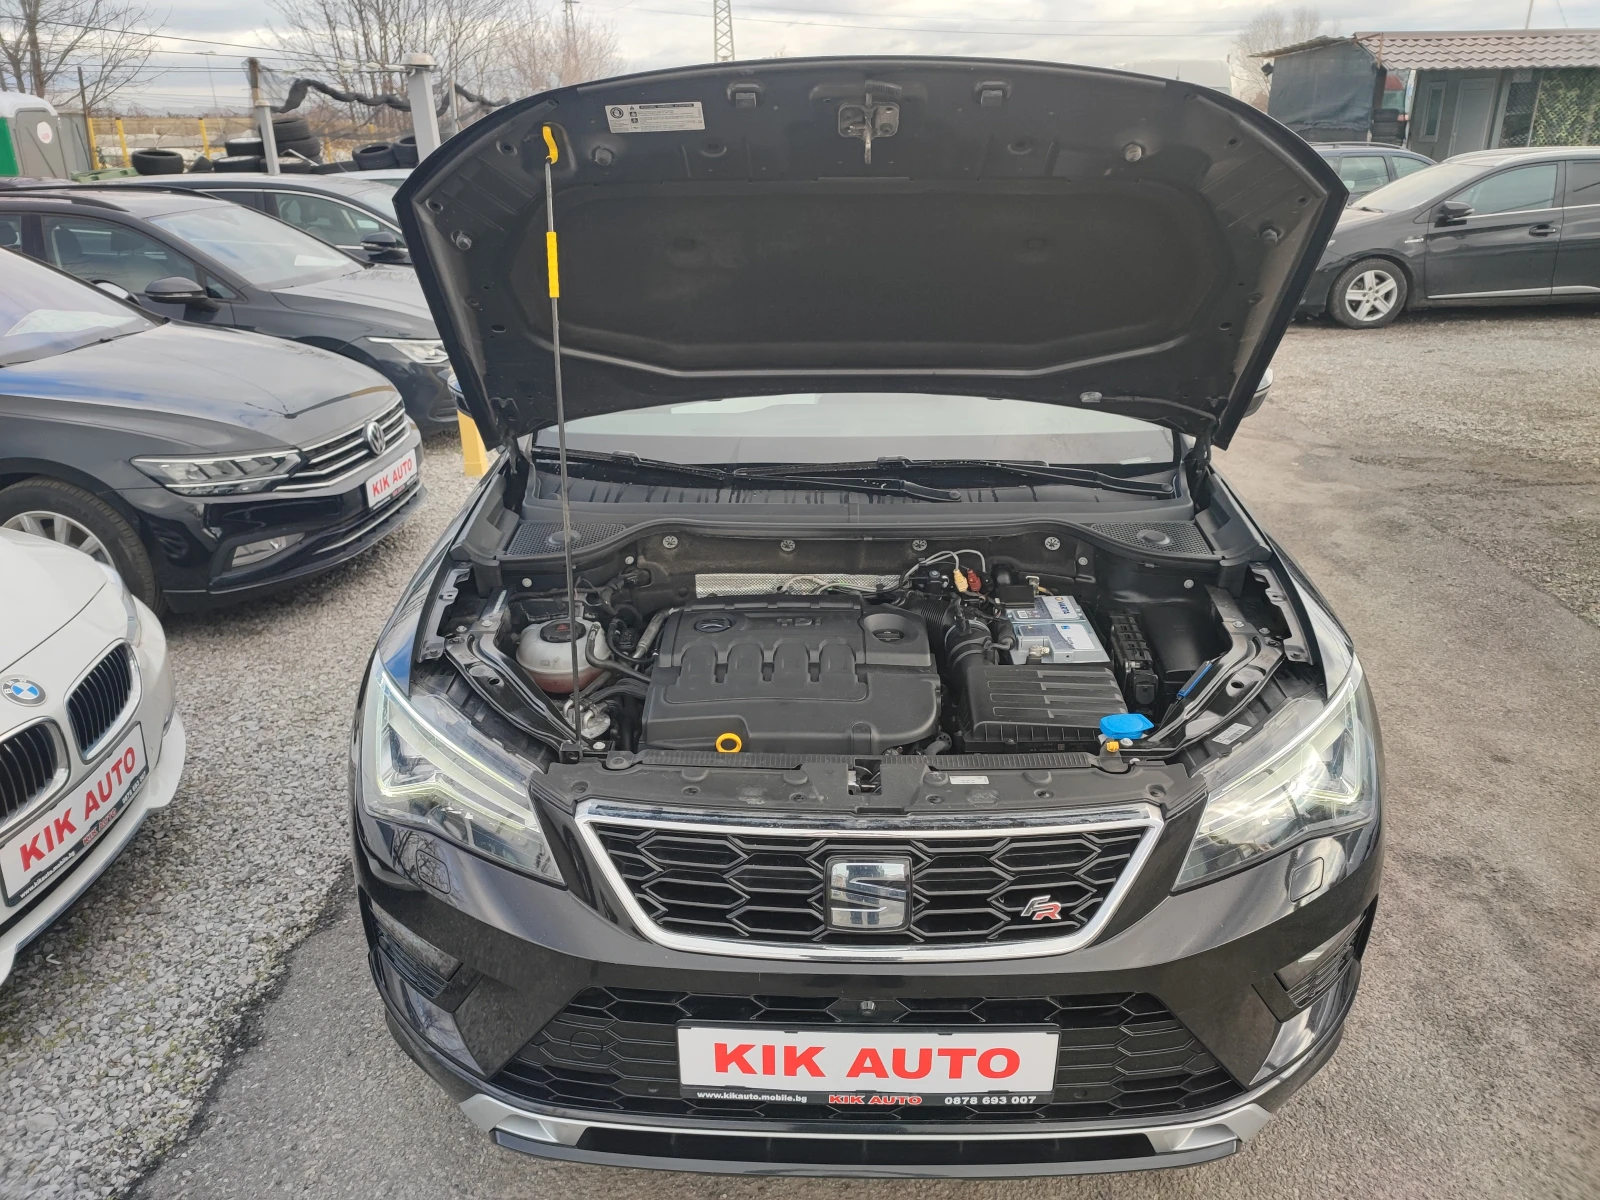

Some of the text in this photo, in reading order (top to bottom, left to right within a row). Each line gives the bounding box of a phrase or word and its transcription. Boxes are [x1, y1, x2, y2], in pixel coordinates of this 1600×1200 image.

[372, 474, 390, 497] KIK
[392, 458, 413, 484] AUTO
[19, 746, 136, 873] KIK AUTO
[1021, 895, 1062, 921] FR
[714, 1042, 1021, 1080] KIK AUTO
[696, 1091, 807, 1104] www.kikauto.mobile.bg
[828, 1094, 923, 1106] KIK AUTO
[944, 1095, 1037, 1105] 0878 693 007
